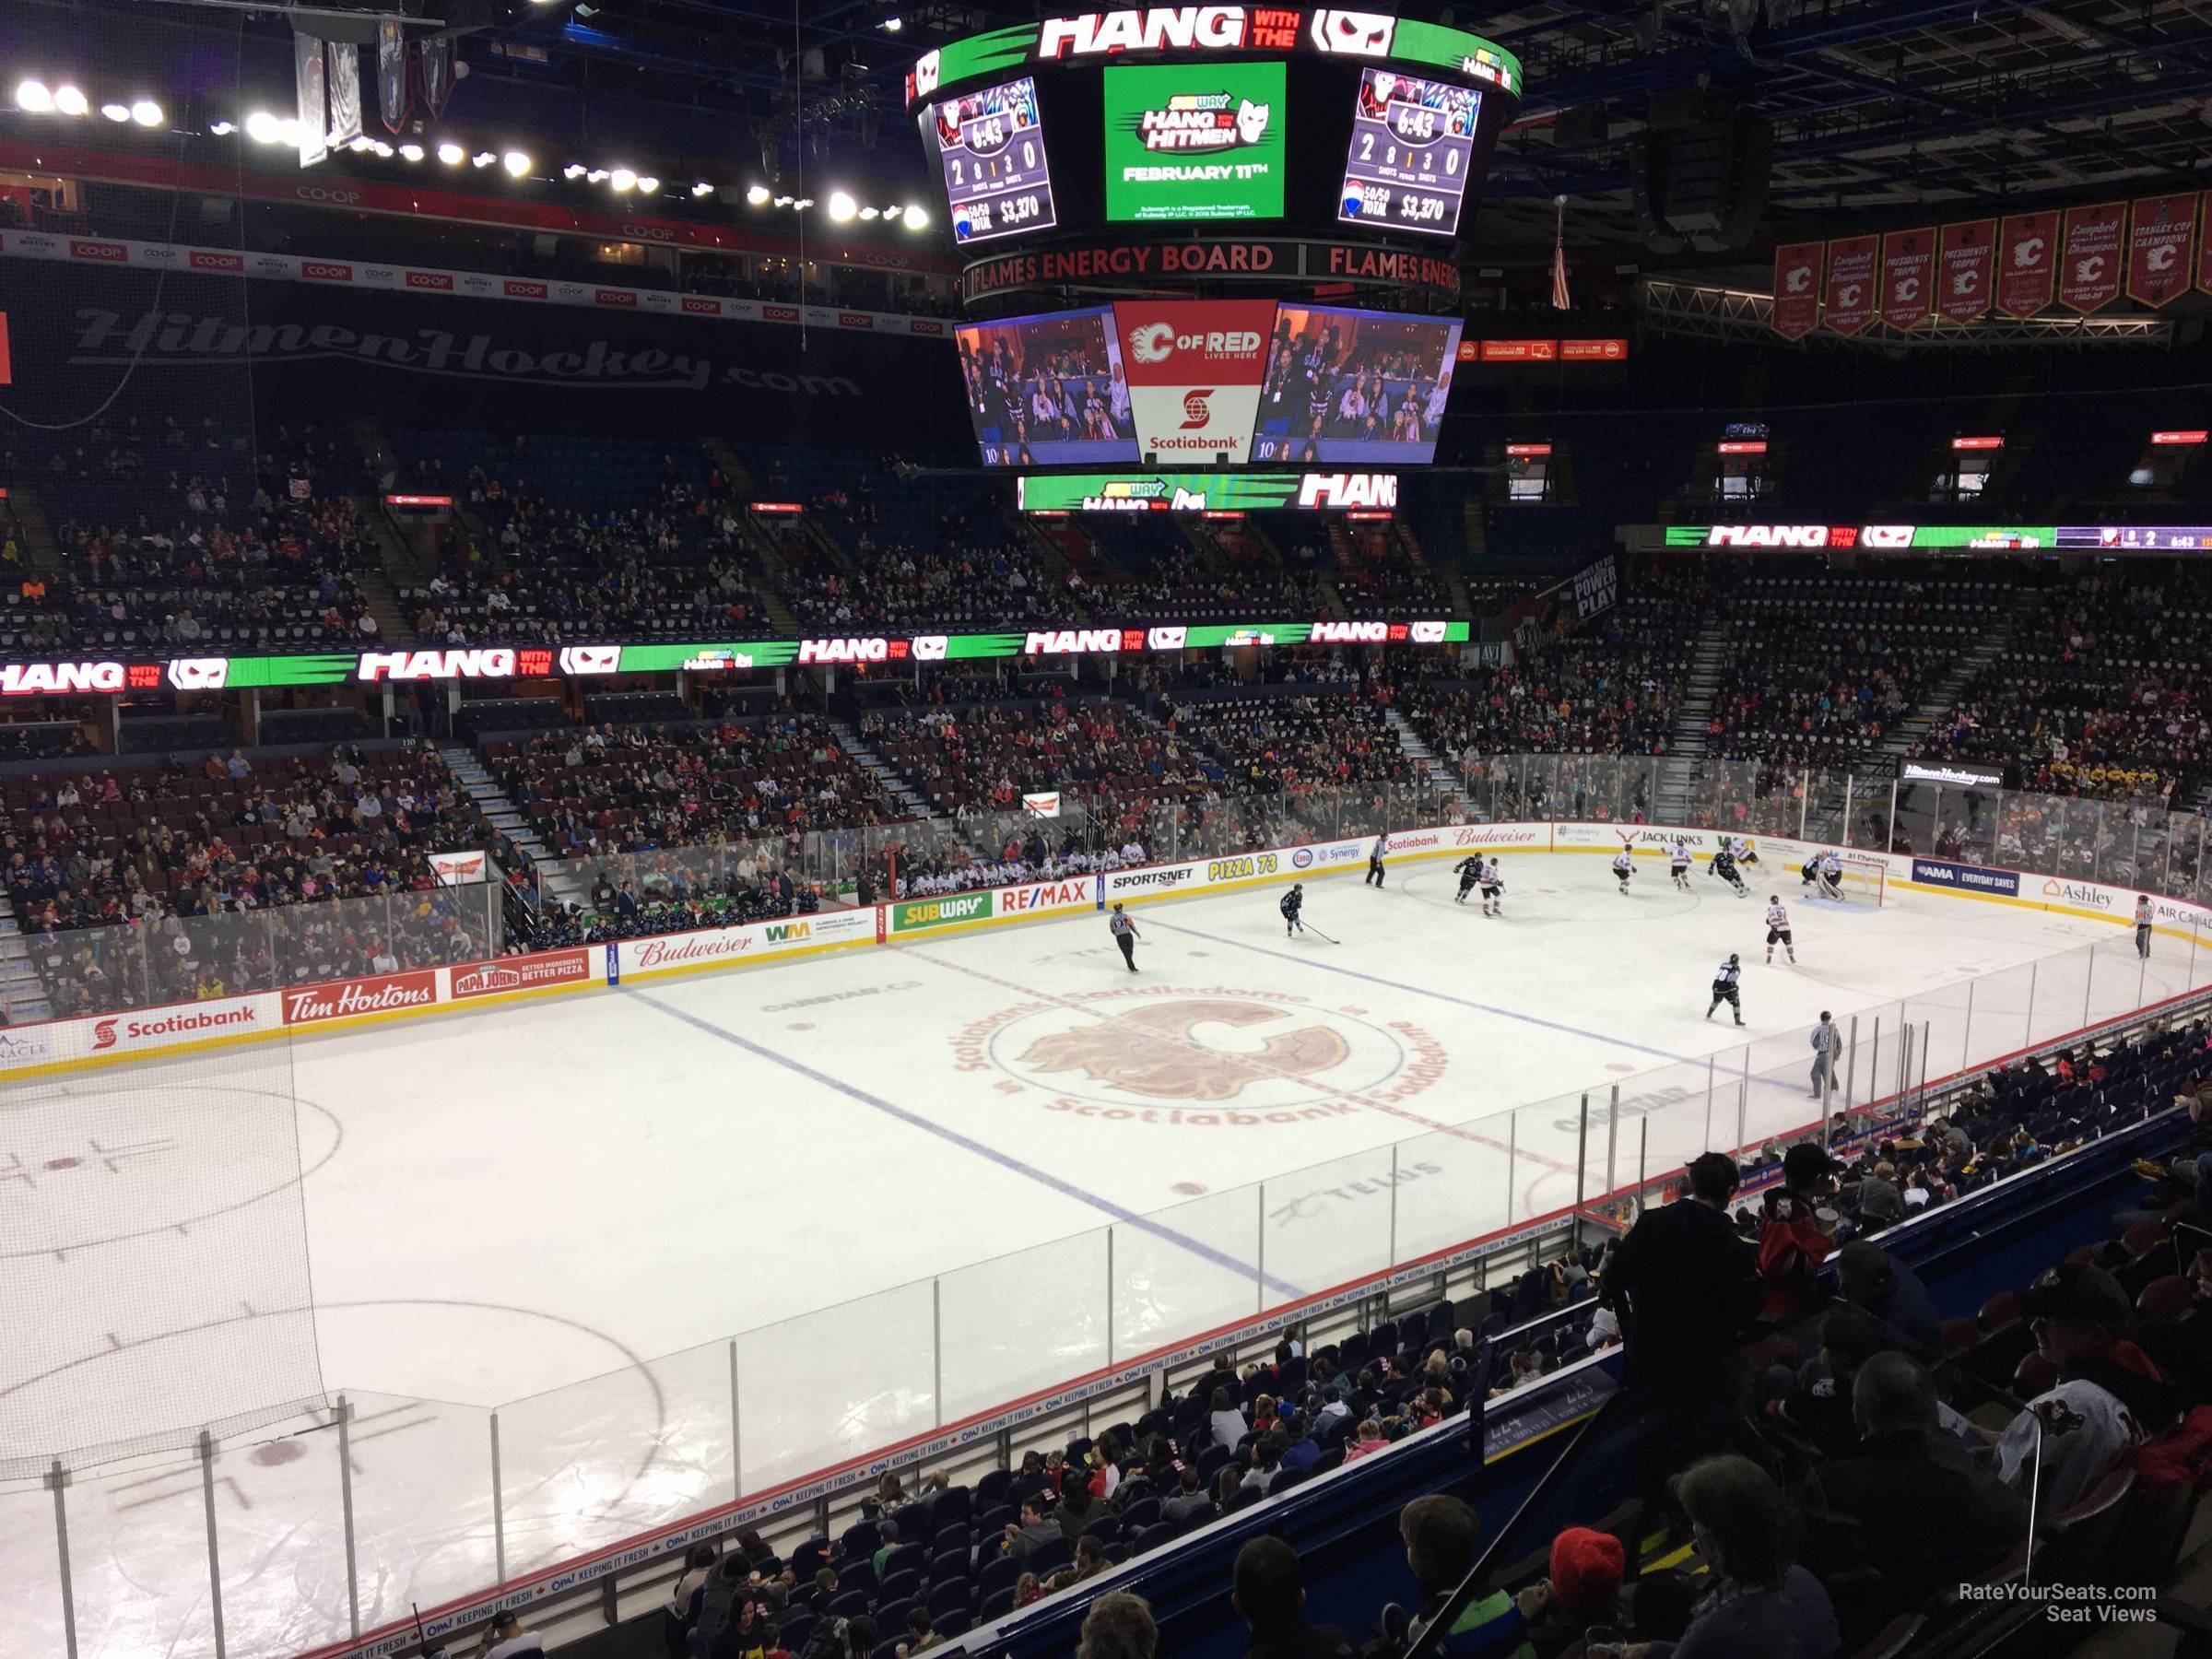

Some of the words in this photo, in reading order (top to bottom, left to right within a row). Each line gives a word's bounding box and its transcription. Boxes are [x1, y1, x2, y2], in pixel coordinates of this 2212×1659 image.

[1253, 9, 1300, 27] WITH
[1039, 6, 1245, 58] HANG
[1253, 29, 1296, 47] THE
[1143, 111, 1216, 129] HANG
[1397, 108, 1435, 139] 6:43
[972, 118, 1004, 148] 6:43
[1147, 128, 1237, 148] HITMEN
[952, 159, 964, 185] 2
[973, 163, 982, 181] 8
[1004, 155, 1013, 173] 3
[1023, 141, 1036, 169] 0
[1359, 134, 1375, 161] 2
[1387, 147, 1396, 165] 8
[1423, 152, 1432, 171] 3
[1446, 148, 1459, 175] 0
[1124, 165, 1233, 182] FEBRUARY
[1235, 163, 1268, 179] 11TH
[1378, 166, 1397, 177] SHOTS
[1418, 172, 1437, 183] SHOTS
[297, 185, 360, 206] CO-OP
[1364, 186, 1391, 202] 50/50
[1401, 194, 1444, 221] $3,370
[969, 203, 990, 218] 50/50
[1000, 195, 1039, 224] $3,370
[1362, 199, 1387, 217] TOTAL
[623, 224, 674, 241] CO-OP
[971, 216, 993, 232] TOTAL
[2135, 223, 2172, 237] STANLEY
[2174, 221, 2193, 231] CUP
[2135, 233, 2188, 248] CHAMPIONS
[76, 242, 123, 260] CO-OP
[1887, 253, 1929, 267] PRESIDENTS
[1944, 245, 1989, 260] PRESIDENTS
[195, 253, 238, 269] CO-OP
[974, 250, 1037, 291] FLAMES
[1043, 245, 1150, 277] ENERGY
[1162, 243, 1275, 273] BOARD
[1331, 247, 1418, 280] FLAMES
[1951, 258, 1981, 270] TROPHY
[307, 264, 347, 280] CO-OP
[1893, 265, 1922, 277] TROPHY
[412, 275, 449, 288] CO-OP
[508, 283, 544, 296] CO-OP
[600, 291, 634, 304] CO-OP
[1176, 335, 1205, 349] OF
[1206, 331, 1262, 352] RED
[1149, 436, 1238, 449] Scotiabank
[1259, 441, 1275, 458] 10
[985, 448, 999, 465] 10
[1104, 483, 1162, 498] SUBWAY
[1299, 474, 1397, 507] HANG
[1709, 524, 1830, 547] HANG
[1831, 527, 1857, 537] WITH
[1832, 536, 1855, 547] THE
[2146, 531, 2157, 547] 2
[2171, 536, 2195, 547] 6:43
[1575, 565, 1618, 602] POWER
[1578, 582, 1618, 619] PLAY
[1312, 621, 1389, 642] HANG
[1390, 624, 1408, 633] WITH
[1389, 631, 1407, 641] THE
[1025, 629, 1122, 653] HANG
[1124, 630, 1145, 641] WITH
[1123, 640, 1144, 650] THE
[799, 639, 888, 663] HANG
[888, 641, 908, 651] WITH
[888, 648, 907, 658] THE
[129, 665, 160, 678] WITH
[359, 649, 515, 681] HANG
[520, 651, 552, 664] WITH
[520, 663, 551, 676] THE
[129, 676, 159, 688] THE
[1903, 765, 2000, 786] HitmenHockey.com
[1387, 834, 1440, 852] Scotiabank
[1453, 828, 1536, 846] Budweiser
[1641, 830, 1669, 843] JACK
[1669, 832, 1703, 845] LINK'S
[1295, 853, 1311, 864] Esso
[1330, 847, 1360, 861] Synergy
[1207, 856, 1253, 881] PIZZA
[1257, 853, 1277, 875] 73
[1113, 868, 1194, 889] SPORTSNET
[1924, 865, 1954, 880] AMA
[1961, 872, 1994, 886] EVERYDAY
[1994, 877, 2015, 889] SAVES
[1002, 881, 1087, 912] RE/MAX
[2062, 883, 2114, 909] Ashley
[903, 894, 983, 925] SUBWAY
[2158, 905, 2176, 919] AIR
[765, 922, 811, 943] WM
[634, 935, 752, 967] Budweiser
[522, 964, 544, 973] BETTER
[522, 969, 557, 982] BETTER
[558, 964, 585, 977] PIZZA.
[457, 974, 486, 994] PAPA
[485, 969, 520, 990] JOHNS
[288, 990, 333, 1021] Tim
[337, 982, 430, 1014] Hortons
[127, 1006, 256, 1039] Scotiabank
[947, 1000, 1042, 1073] Scotiabank
[1062, 984, 1311, 1005] Saddledome
[1042, 1098, 1362, 1126] Scotiabank
[691, 1521, 723, 1541] KEEPING
[732, 1508, 757, 1526] FRESH
[550, 1573, 576, 1593] OPA!
[578, 1559, 613, 1583] KEEPING
[614, 1555, 623, 1568] IT
[623, 1547, 650, 1567] FRESH
[427, 1618, 453, 1639] OPA!
[455, 1606, 494, 1629] KEEPING
[494, 1600, 504, 1612] IT
[504, 1590, 534, 1611] FRESH
